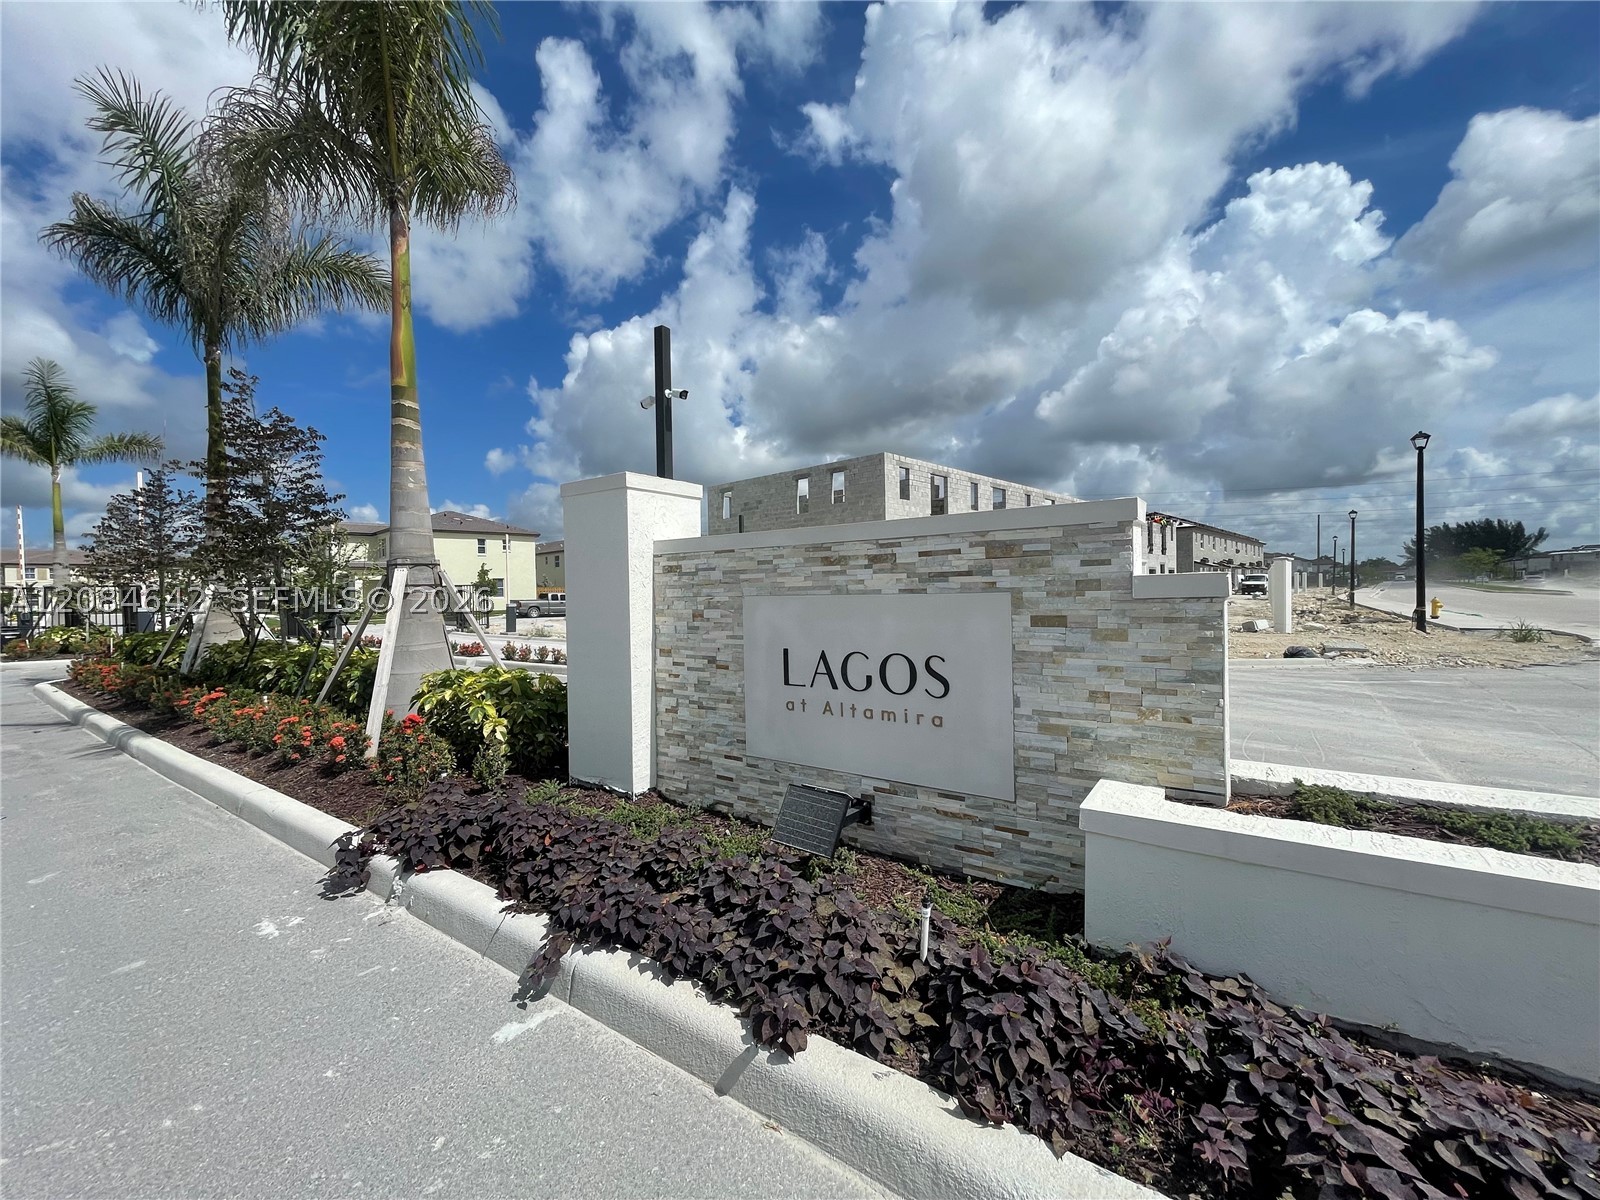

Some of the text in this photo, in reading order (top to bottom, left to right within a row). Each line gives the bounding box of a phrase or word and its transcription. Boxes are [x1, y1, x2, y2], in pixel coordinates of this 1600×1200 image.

[783, 648, 950, 699] LAGOS
[786, 699, 944, 728] at Altamira
